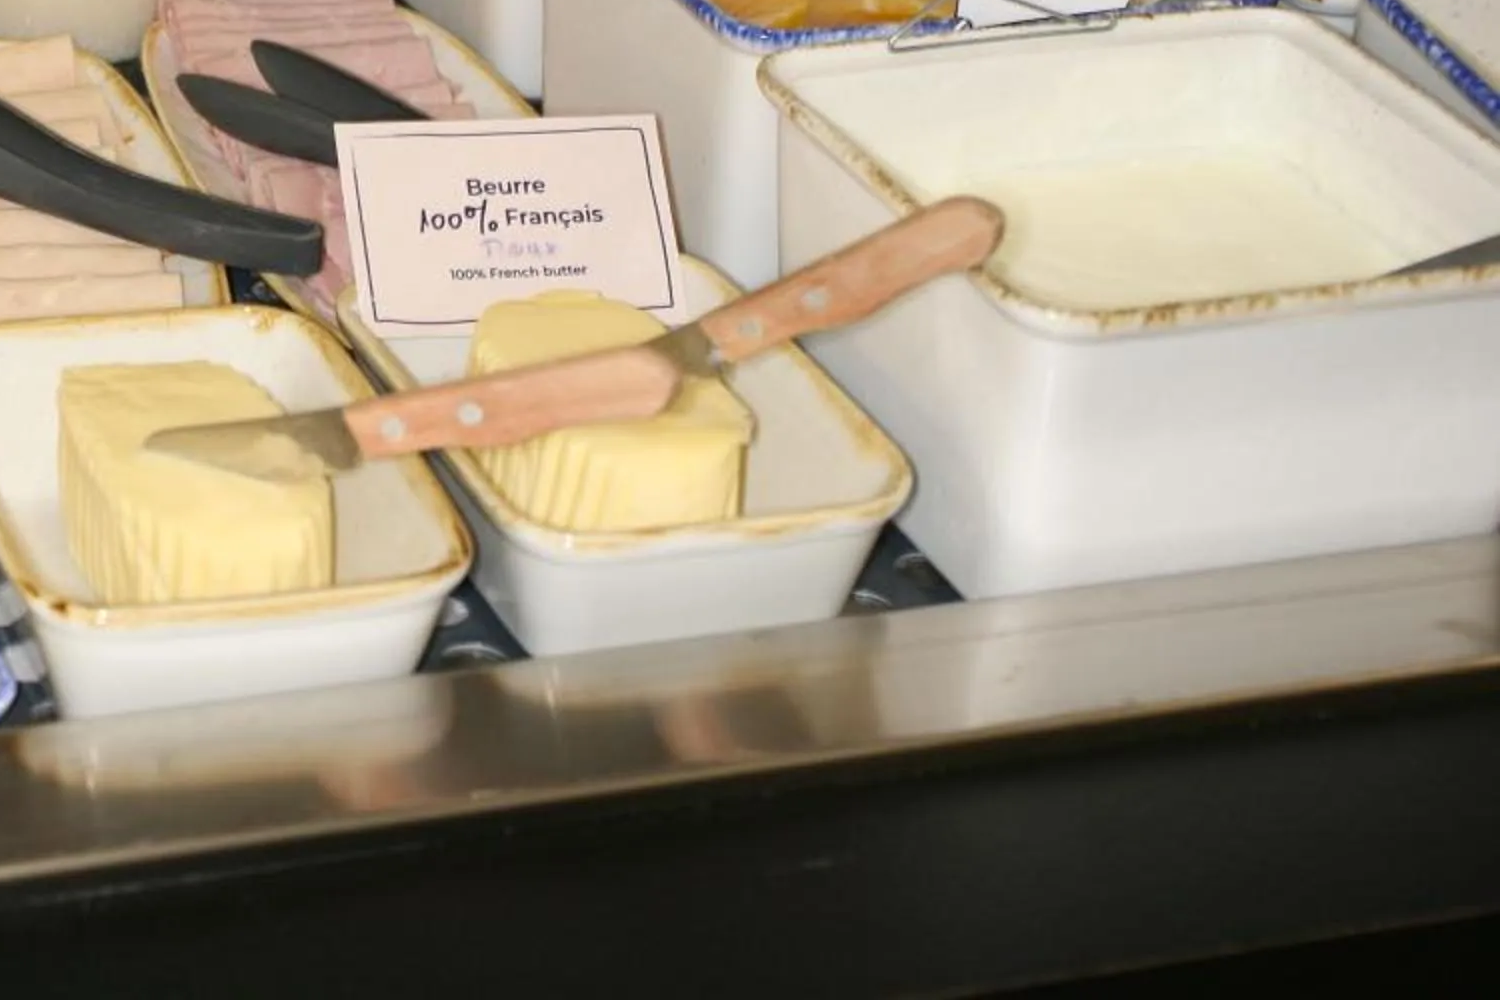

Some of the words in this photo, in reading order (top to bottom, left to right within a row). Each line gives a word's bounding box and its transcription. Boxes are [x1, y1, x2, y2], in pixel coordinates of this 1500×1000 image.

[466, 178, 546, 197] Beurre
[419, 199, 499, 235] 100%
[505, 204, 605, 229] Français
[449, 267, 487, 281] 100%
[489, 266, 540, 280] French
[543, 264, 588, 278] butter
